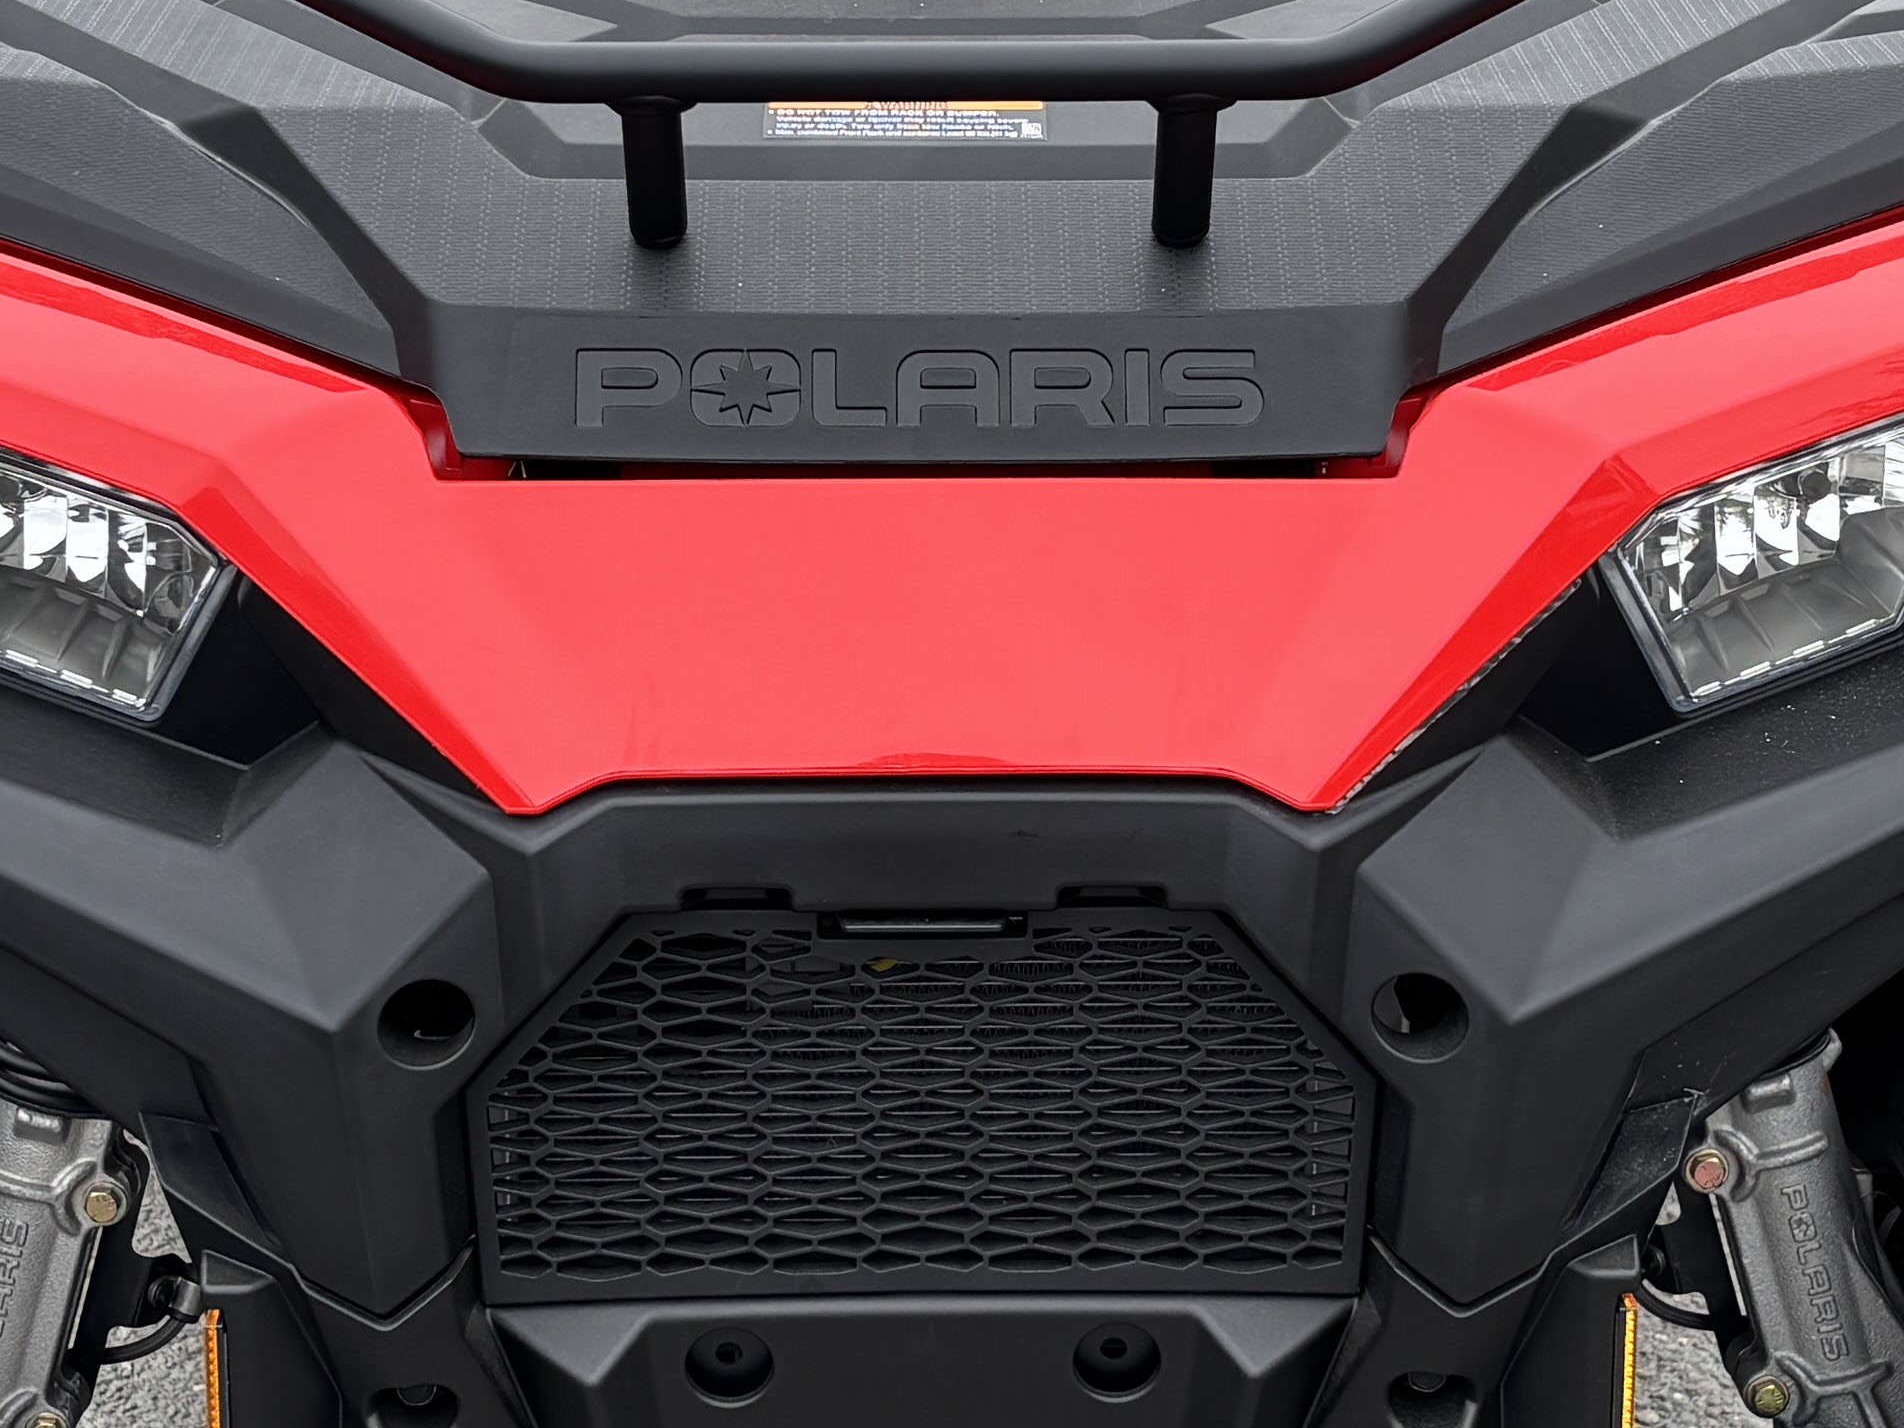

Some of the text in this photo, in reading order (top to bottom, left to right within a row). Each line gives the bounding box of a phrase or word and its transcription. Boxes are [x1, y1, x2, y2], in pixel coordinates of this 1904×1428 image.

[825, 109, 851, 117] TOW
[854, 109, 888, 117] FROM
[575, 348, 1265, 427] POLARIS
[1781, 1183, 1850, 1362] POLARIS
